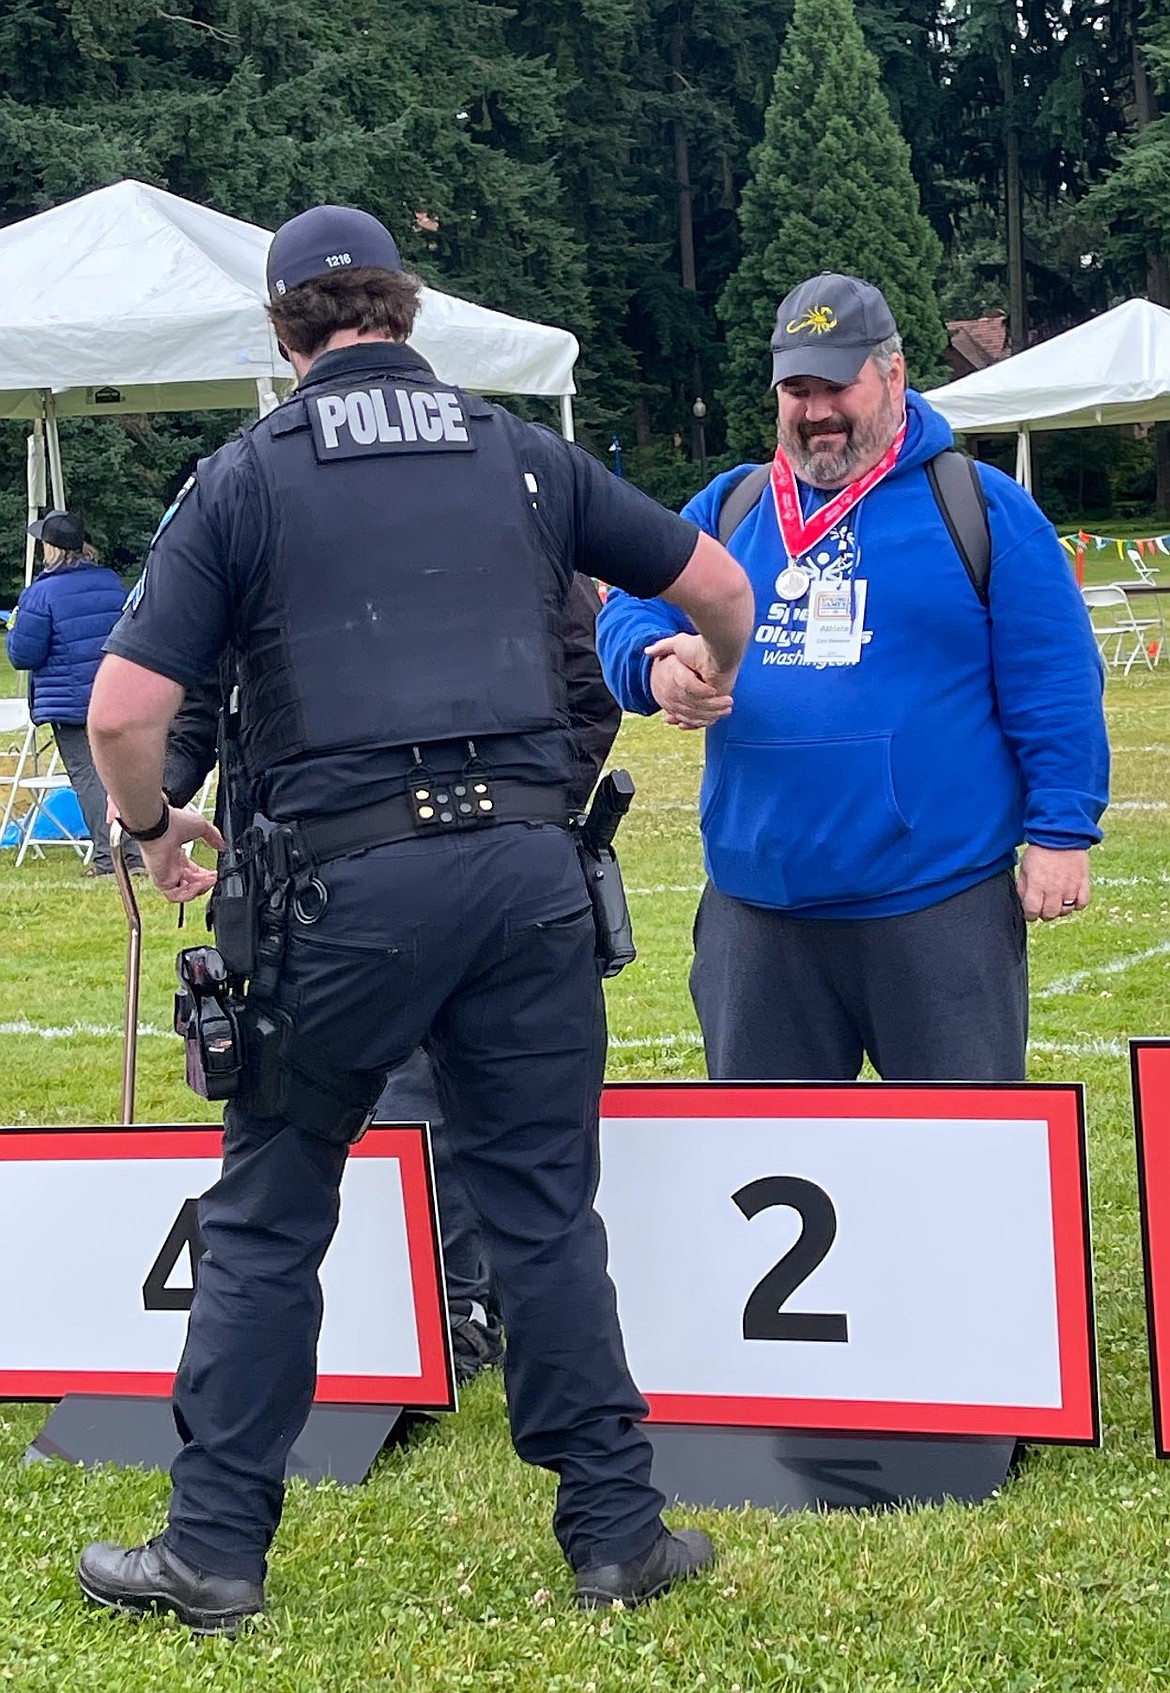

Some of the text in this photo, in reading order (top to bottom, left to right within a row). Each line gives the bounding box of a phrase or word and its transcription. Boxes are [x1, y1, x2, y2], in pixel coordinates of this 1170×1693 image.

[325, 253, 352, 268] 1216
[317, 389, 469, 449] POLICE
[754, 624, 874, 648] Olyms
[731, 1175, 849, 1343] 2
